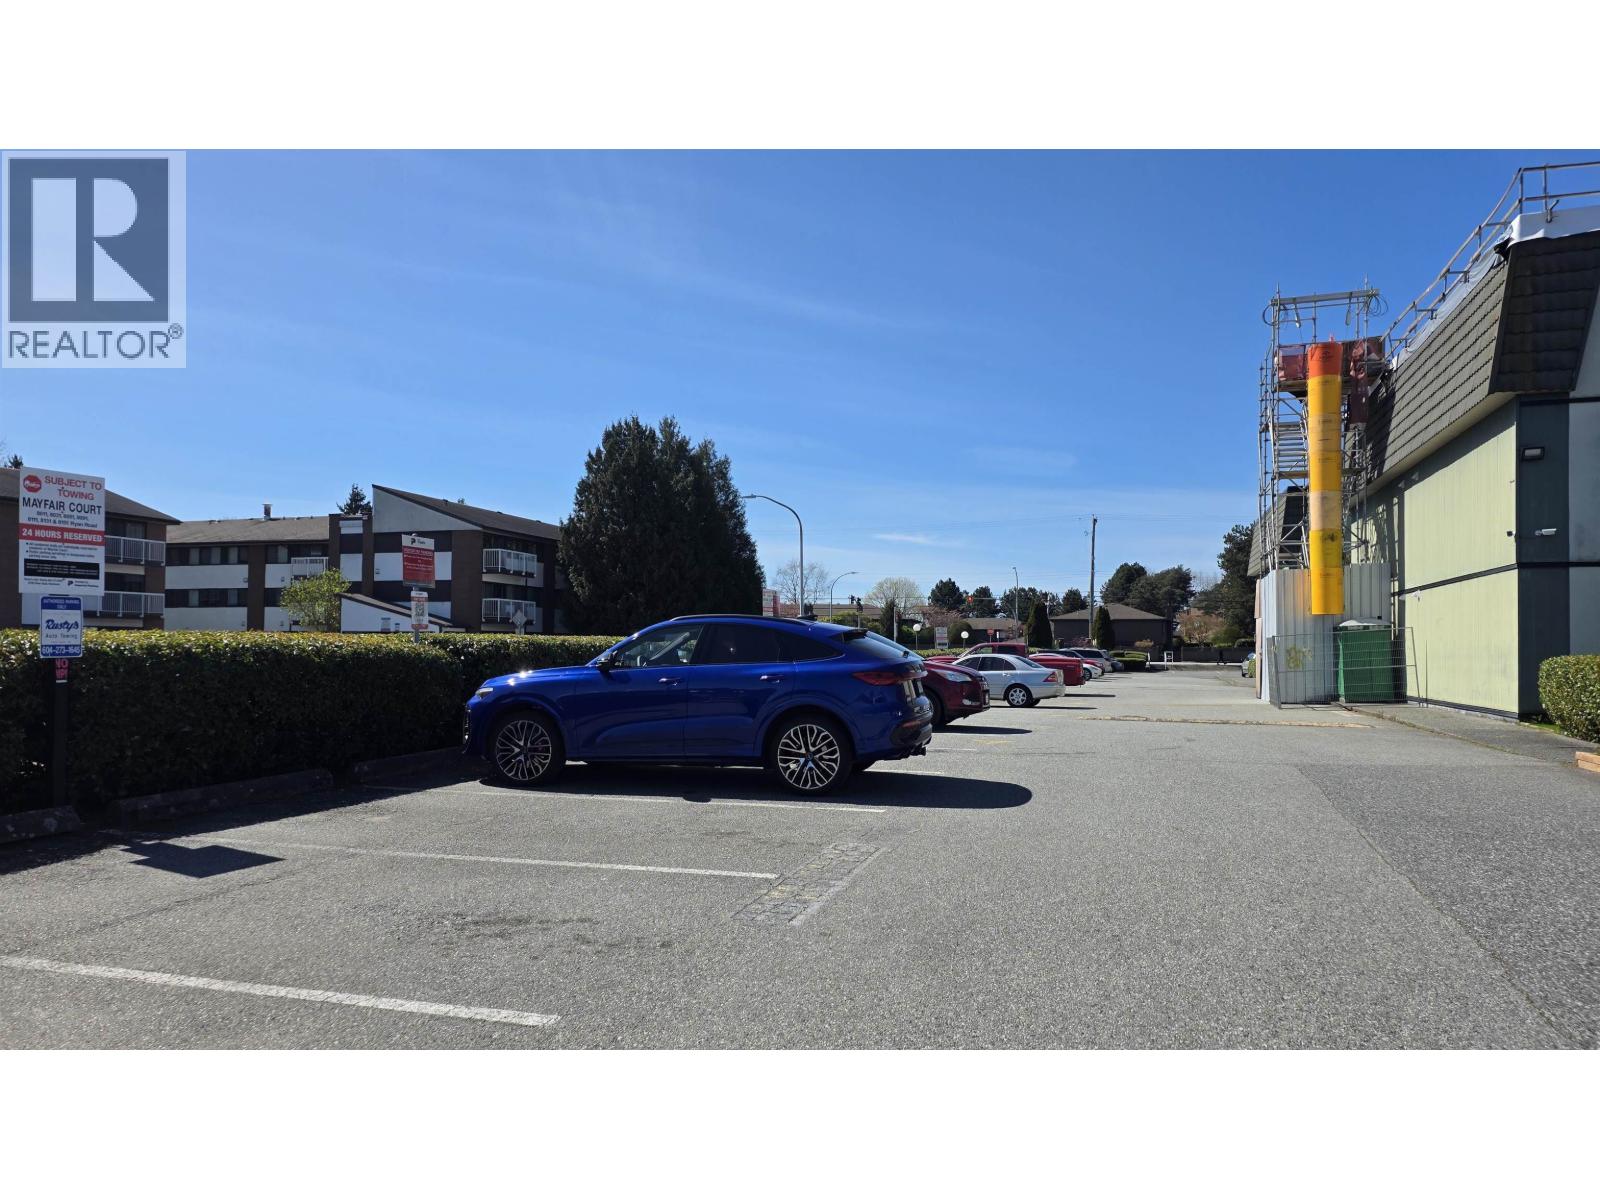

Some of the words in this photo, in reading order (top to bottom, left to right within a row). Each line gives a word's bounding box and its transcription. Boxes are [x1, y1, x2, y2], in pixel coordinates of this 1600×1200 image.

[44, 475, 87, 488] SUBJECT
[89, 481, 102, 490] TO
[57, 488, 95, 500] TOWING
[22, 497, 66, 511] MAYFAIR
[68, 502, 102, 515] COURT
[22, 528, 33, 537] 24
[34, 529, 62, 539] HOURS
[64, 532, 102, 542] RESERVED
[45, 618, 79, 632] Rusty's
